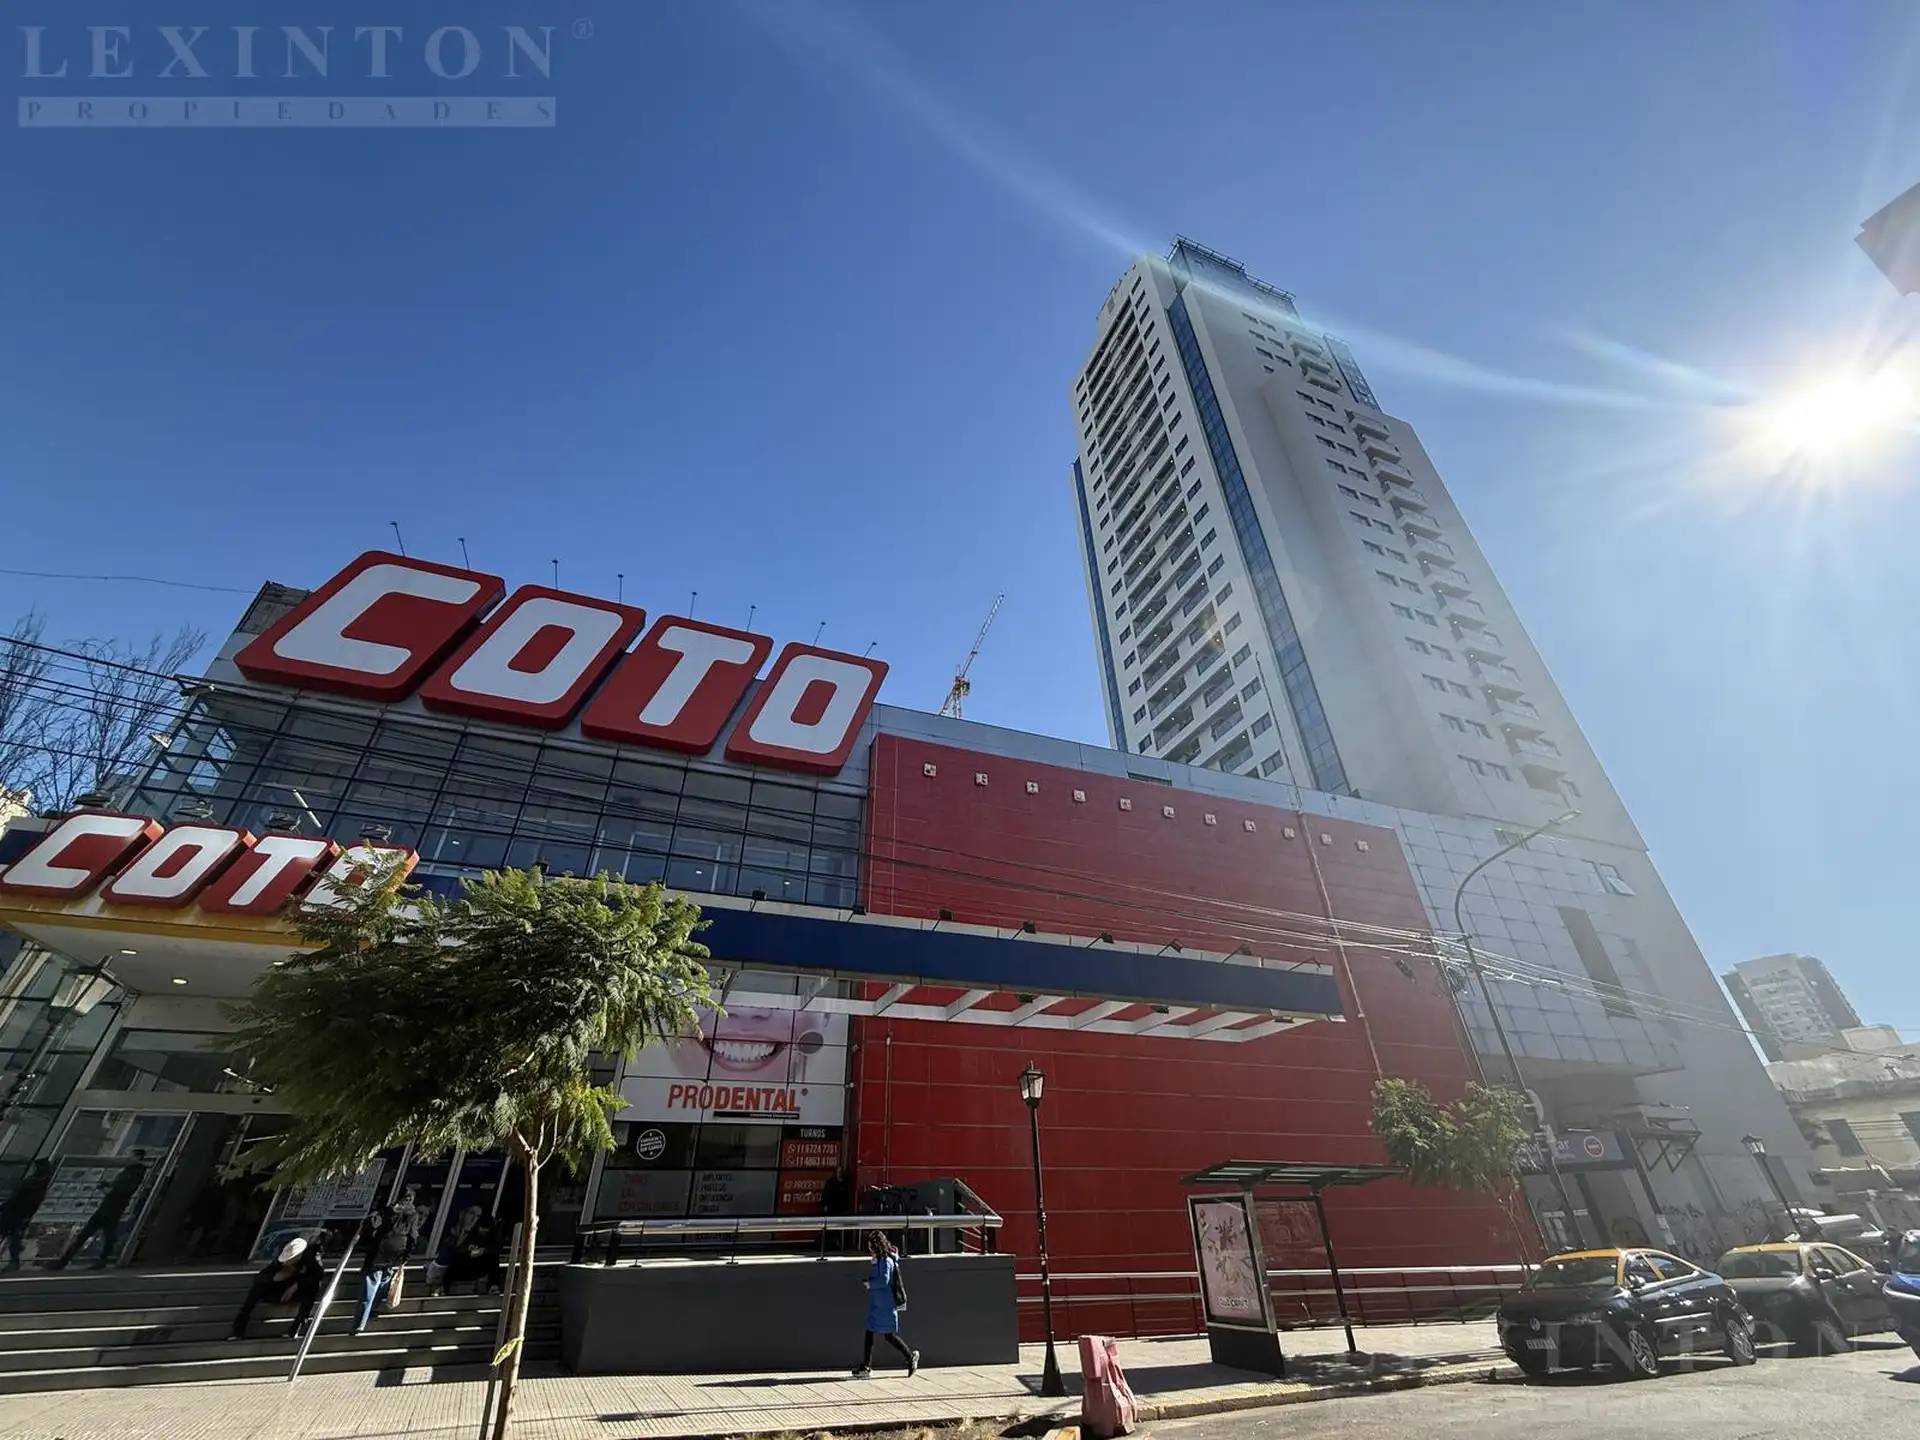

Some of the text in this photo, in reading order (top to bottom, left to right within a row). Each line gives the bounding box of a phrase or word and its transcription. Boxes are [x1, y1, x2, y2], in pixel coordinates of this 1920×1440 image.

[272, 563, 873, 755] COTO
[3, 814, 409, 914] COTO
[667, 1084, 801, 1112] PRODENTAL
